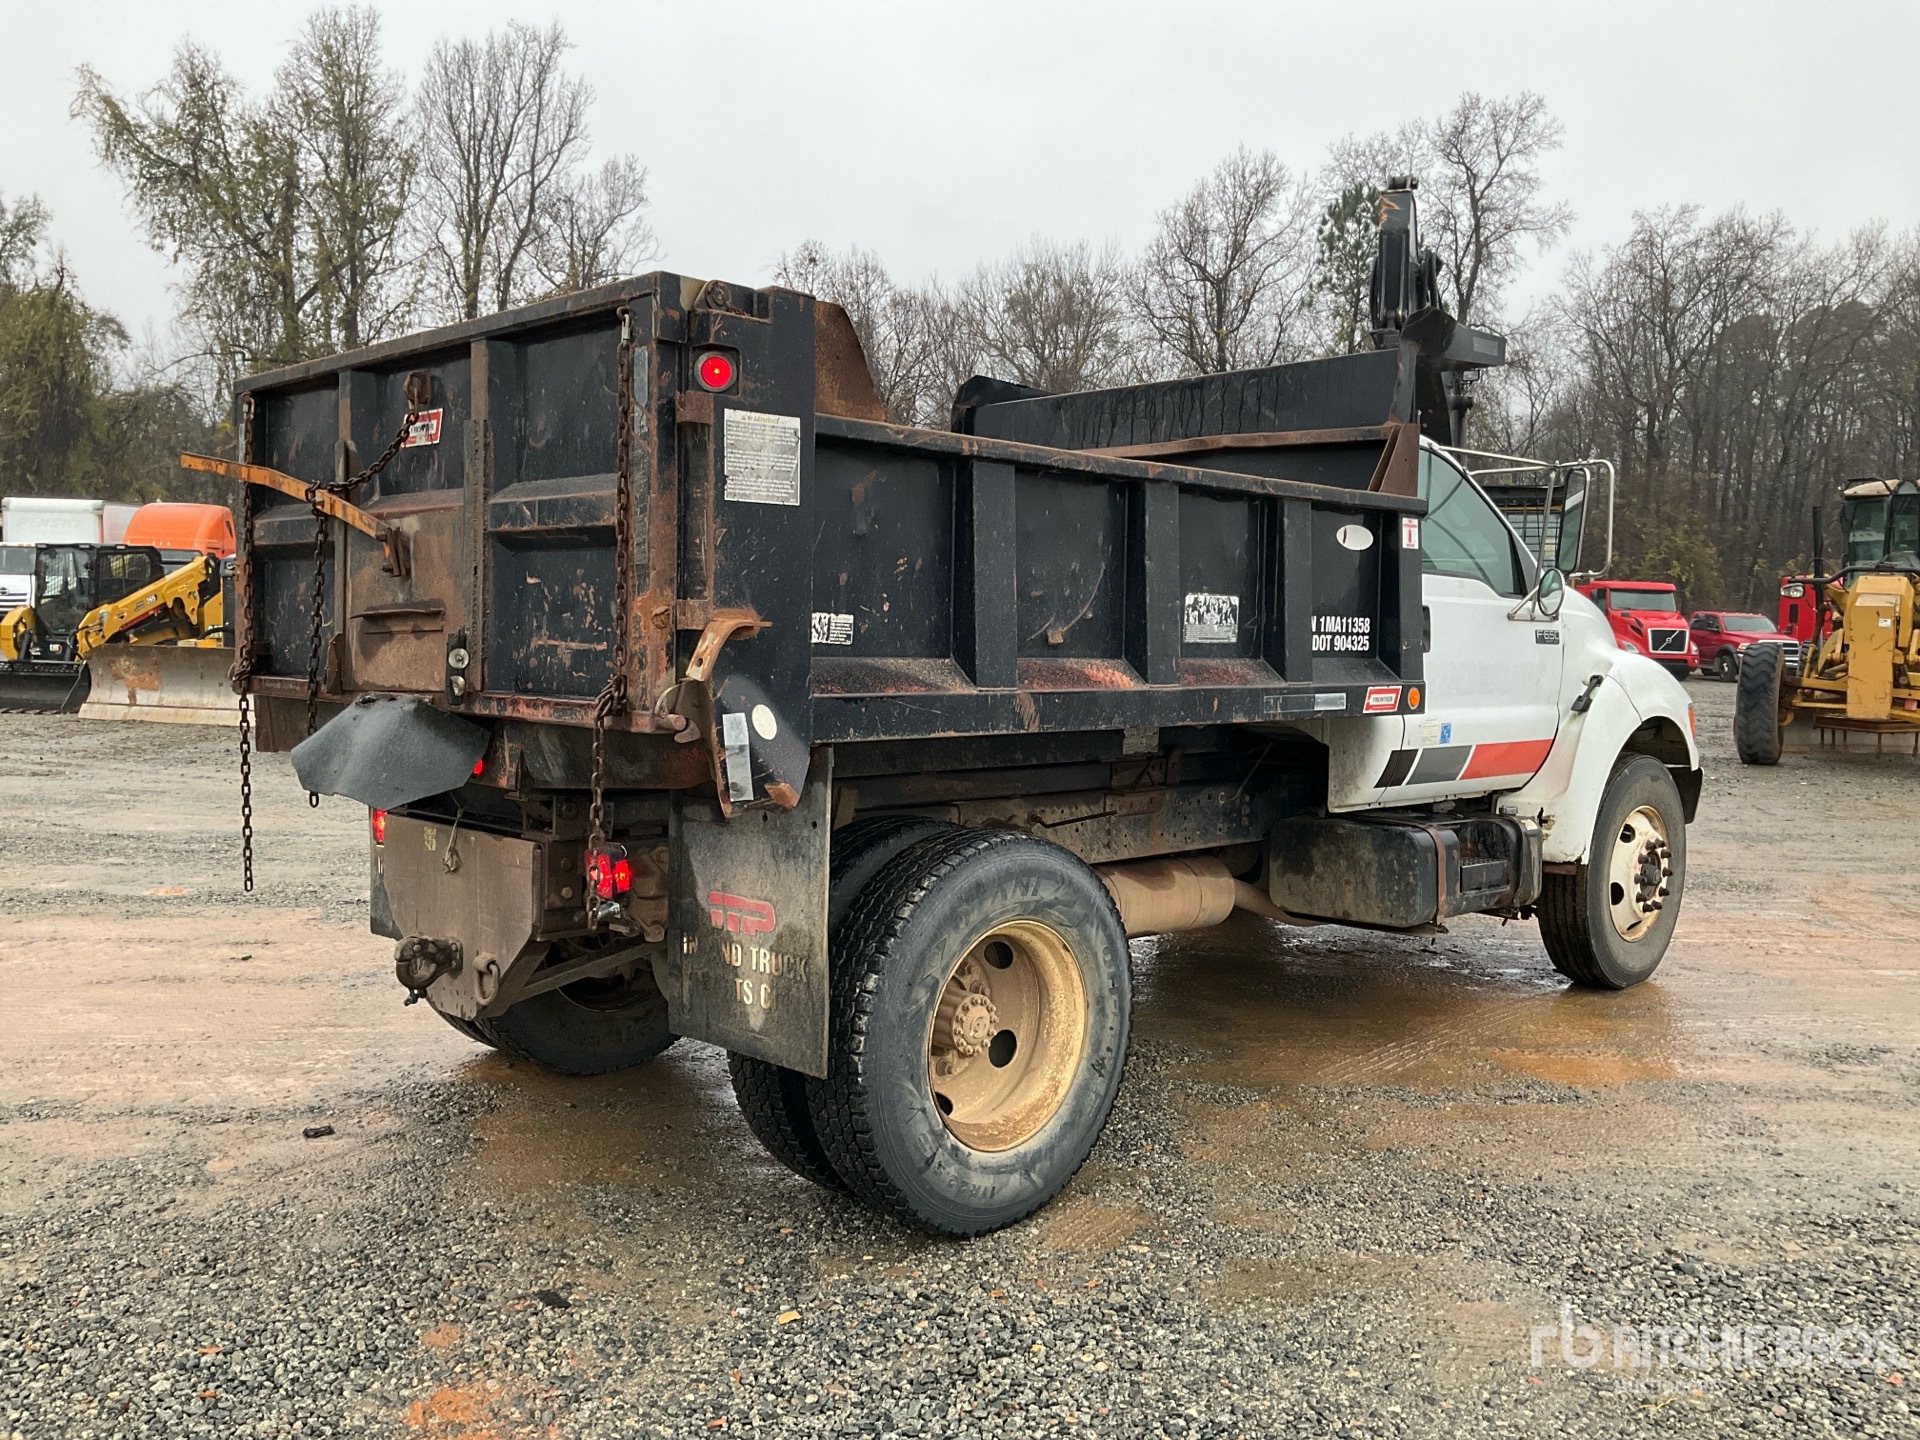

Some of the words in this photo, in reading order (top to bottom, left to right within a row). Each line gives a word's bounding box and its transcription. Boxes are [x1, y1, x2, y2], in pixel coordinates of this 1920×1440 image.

[1320, 616, 1370, 633] 1MA11358
[1312, 635, 1332, 651] DOT
[1334, 635, 1370, 651] 904325
[750, 944, 808, 983] TRUCK
